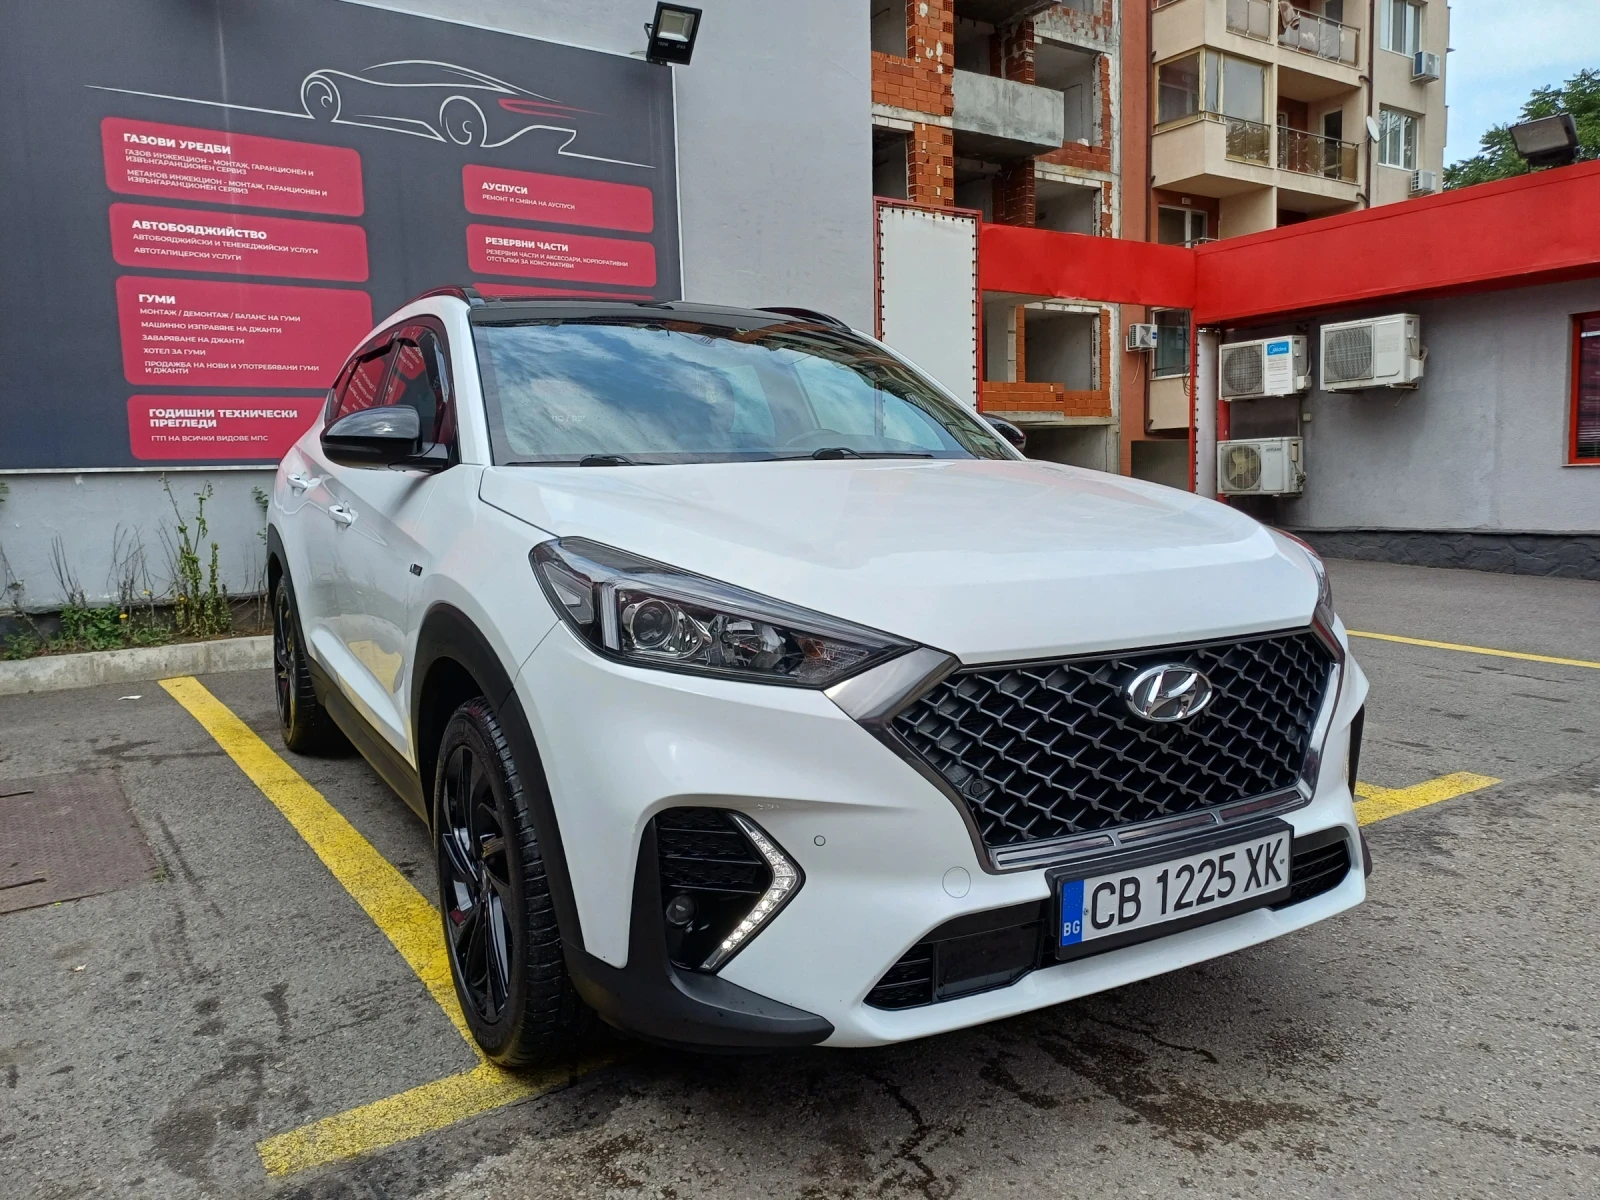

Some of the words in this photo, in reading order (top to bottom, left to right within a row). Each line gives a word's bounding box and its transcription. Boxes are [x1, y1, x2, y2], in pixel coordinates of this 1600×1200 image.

[123, 133, 176, 148] ГАЗОВИ
[179, 140, 231, 155] УРЕДБИ
[125, 148, 152, 158] ГАЗОВ
[153, 152, 207, 164] ИНЖЕКЦИОН
[213, 159, 250, 170] МОНТАЖ,
[251, 163, 307, 176] ГАРАНЦИОНЕН
[125, 155, 215, 171] ИЗВЪНГАРАНЦИОНЕН
[216, 166, 247, 175] СЕРВИЗ
[127, 169, 168, 179] МЕТАНОВ
[169, 174, 222, 185] ИНЖЕКЦИОН
[228, 181, 265, 190] МОНТАЖ,
[266, 184, 321, 196] ГАРАНЦИОНЕН
[127, 176, 217, 191] ИЗВЪНГАРАНЦИОНЕН
[218, 185, 249, 195] СЕРВИЗ
[481, 182, 528, 195] АУСПУСИ
[482, 194, 508, 202] РЕМОНТ
[515, 198, 538, 206] СМЯНА
[547, 201, 576, 210] АУСПУСИ
[131, 219, 267, 240] АВТОБОЯДЖИЙСТВО
[133, 233, 213, 246] АВТОБОЯДЖИЙСКИ
[222, 240, 289, 252] ТЕНЕКЕДЖИЙСКИ
[290, 246, 319, 255] УСЛУГИ
[485, 236, 535, 249] РЕЗЕРВНИ
[536, 242, 569, 252] ЧАСТИ
[134, 246, 210, 259] АВТОТАПИЦЕРСКИ
[211, 253, 242, 261] УСЛУГИ
[486, 248, 519, 257] РЕЗЕРВНИ
[519, 251, 540, 259] ЧАСТИ
[582, 257, 629, 267] КОРПОРАТИВНИ
[486, 255, 520, 264] ОТСТЪПКИ
[529, 259, 575, 269] КОНСУМАТИВИ
[138, 293, 176, 305] ГУМИ
[140, 308, 177, 316] МОНТАЖ
[183, 310, 229, 318] ДЕМОНТАЖ
[141, 321, 186, 329] МАШИННО
[187, 323, 235, 332] ИЗПРАВЯНЕ
[249, 326, 282, 334] ДЖАНТИ
[142, 334, 197, 343] ЗАВАРЯВАНЕ
[210, 337, 245, 345] ДЖАНТИ
[143, 347, 170, 355] ХОТЕЛ
[144, 360, 192, 368] ПРОДАЖБА
[238, 363, 298, 371] УПОТРЕБЯВАНИ
[153, 367, 189, 375] ДЖАНТИ
[149, 408, 215, 419] ГОДИШНИ
[217, 409, 298, 418] ТЕХНИЧЕСКИ
[150, 418, 217, 429] ПРЕГЛЕДИ
[1091, 876, 1142, 930] CB
[1156, 851, 1236, 916] 1225
[1242, 838, 1284, 893] XK
[1063, 920, 1081, 937] BG
